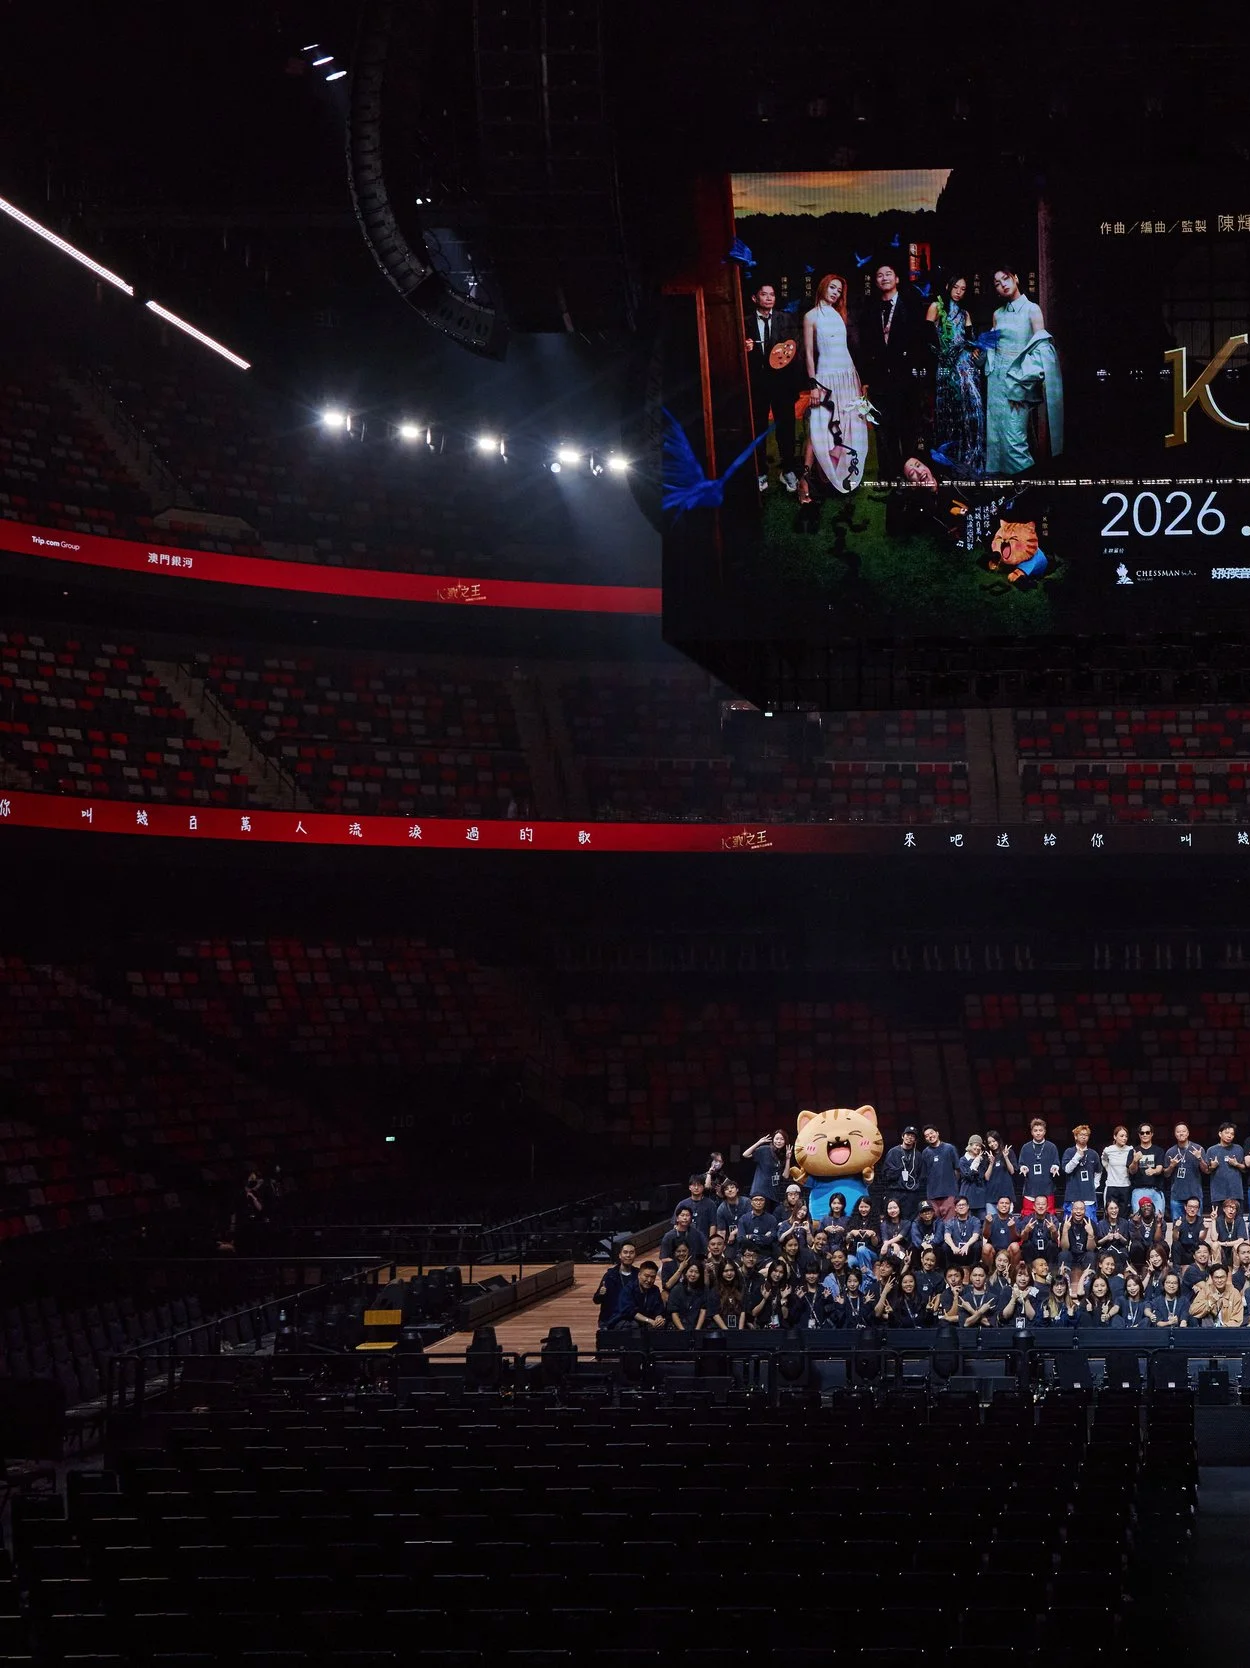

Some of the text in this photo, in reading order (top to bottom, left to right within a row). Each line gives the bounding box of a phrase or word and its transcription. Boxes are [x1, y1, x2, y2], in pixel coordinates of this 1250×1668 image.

[31, 535, 81, 552] Trip.com Group
[147, 551, 194, 569] 澳門銀河
[1136, 569, 1180, 577] CHESSMAN
[721, 829, 767, 850] K歌之王
